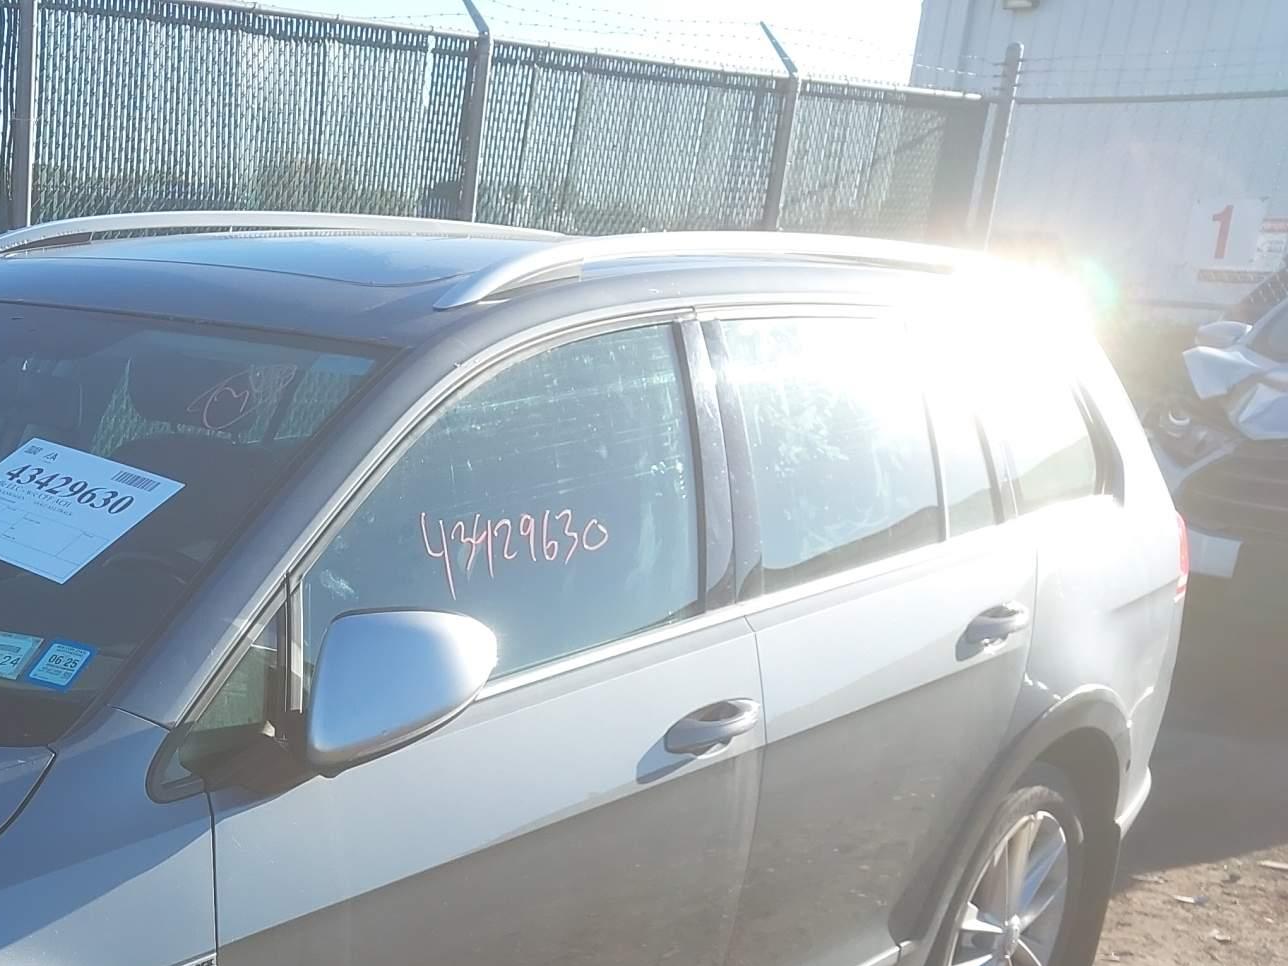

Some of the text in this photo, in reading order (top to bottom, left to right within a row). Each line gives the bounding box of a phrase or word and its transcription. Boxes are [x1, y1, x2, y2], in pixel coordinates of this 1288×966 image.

[1212, 204, 1234, 259] 1
[6, 464, 135, 515] 43429630
[421, 509, 609, 601] 43429630
[0, 655, 21, 667] 24
